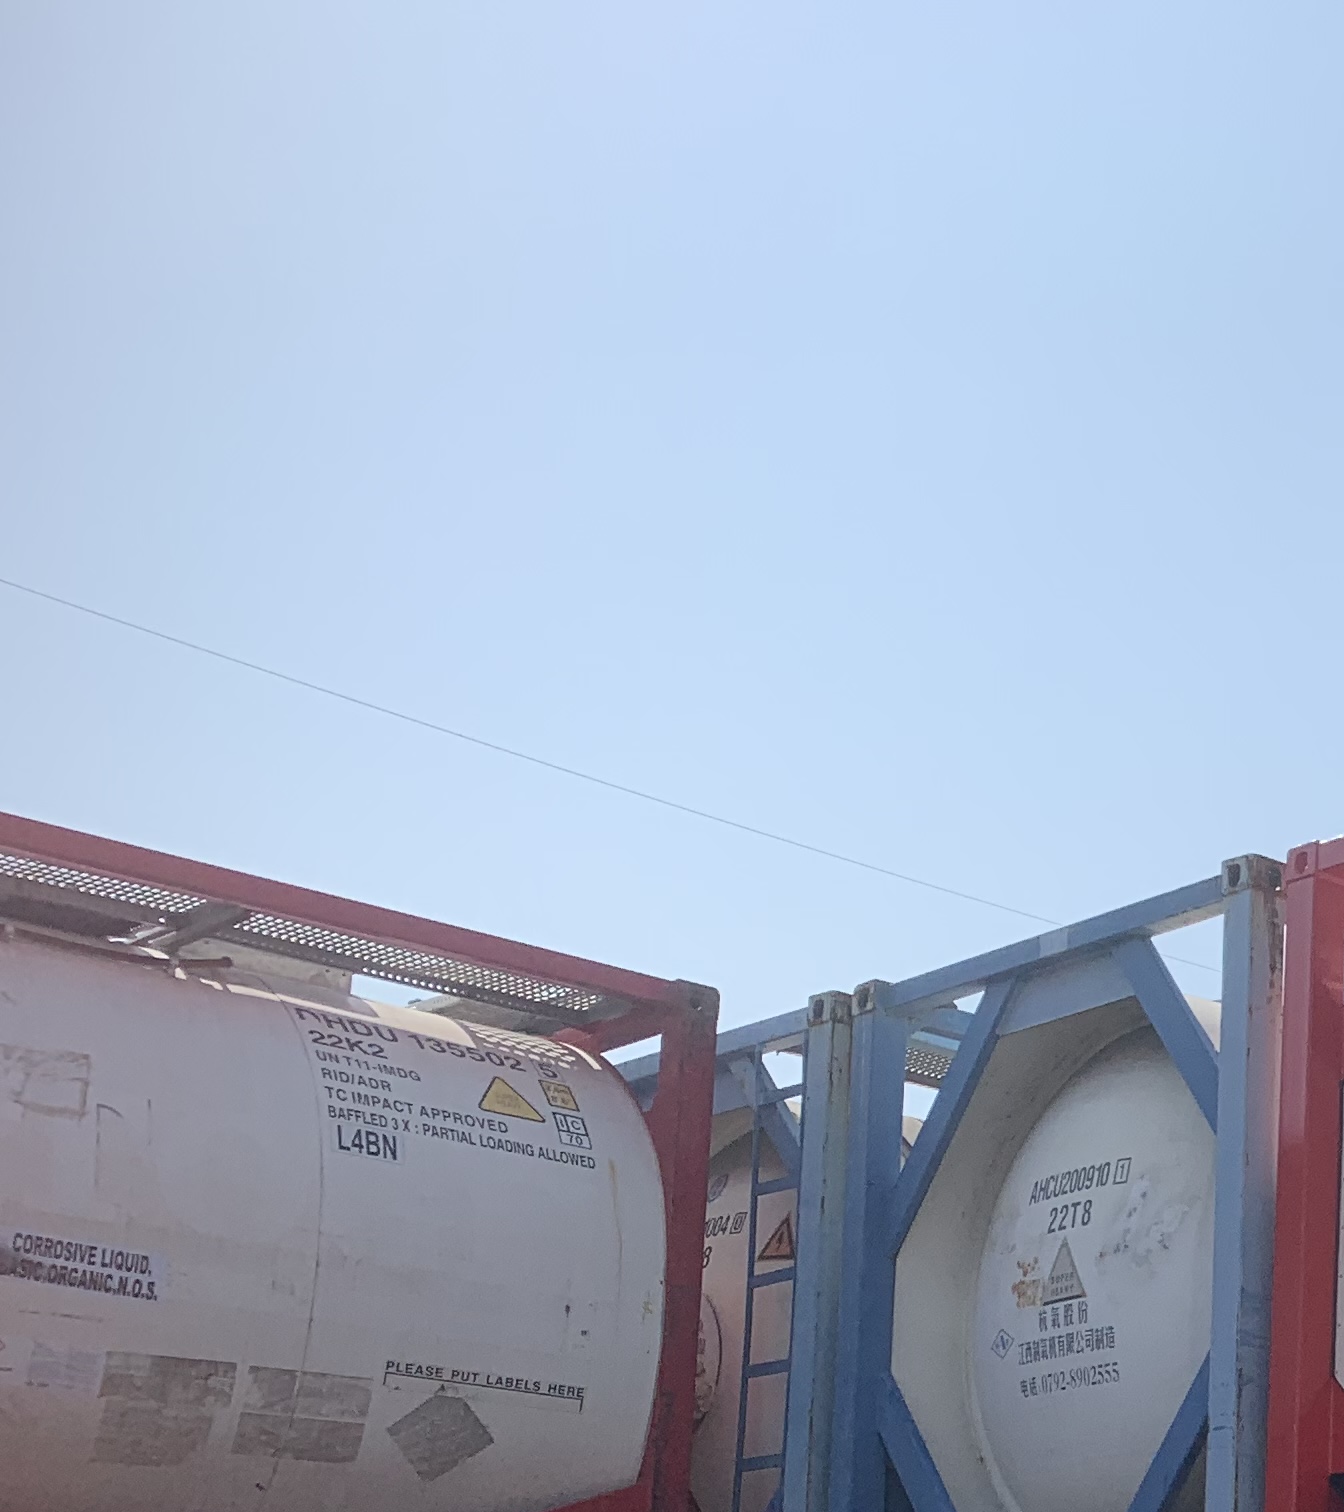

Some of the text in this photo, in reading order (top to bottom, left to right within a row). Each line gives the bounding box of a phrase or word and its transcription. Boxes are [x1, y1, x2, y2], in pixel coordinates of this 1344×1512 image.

[309, 1030, 389, 1060] 22K2
[315, 1050, 340, 1064] UN
[408, 1034, 527, 1073] 135502
[321, 1068, 393, 1093] RID/ADR
[325, 1086, 509, 1134] TC IMPACT APPROVED
[327, 1105, 388, 1128] BAFFLED
[391, 1117, 399, 1131] 3
[422, 1124, 477, 1147] PARTIAL
[480, 1136, 535, 1157] LOADING
[538, 1147, 596, 1170] ALLOWED
[337, 1125, 398, 1161] L4BN
[1029, 1162, 1111, 1206] AHCU200910
[1047, 1199, 1093, 1234] 22T8
[12, 1232, 97, 1268] CORROSIVE
[385, 1360, 585, 1399] PLEASE PUT LABELS HERE
